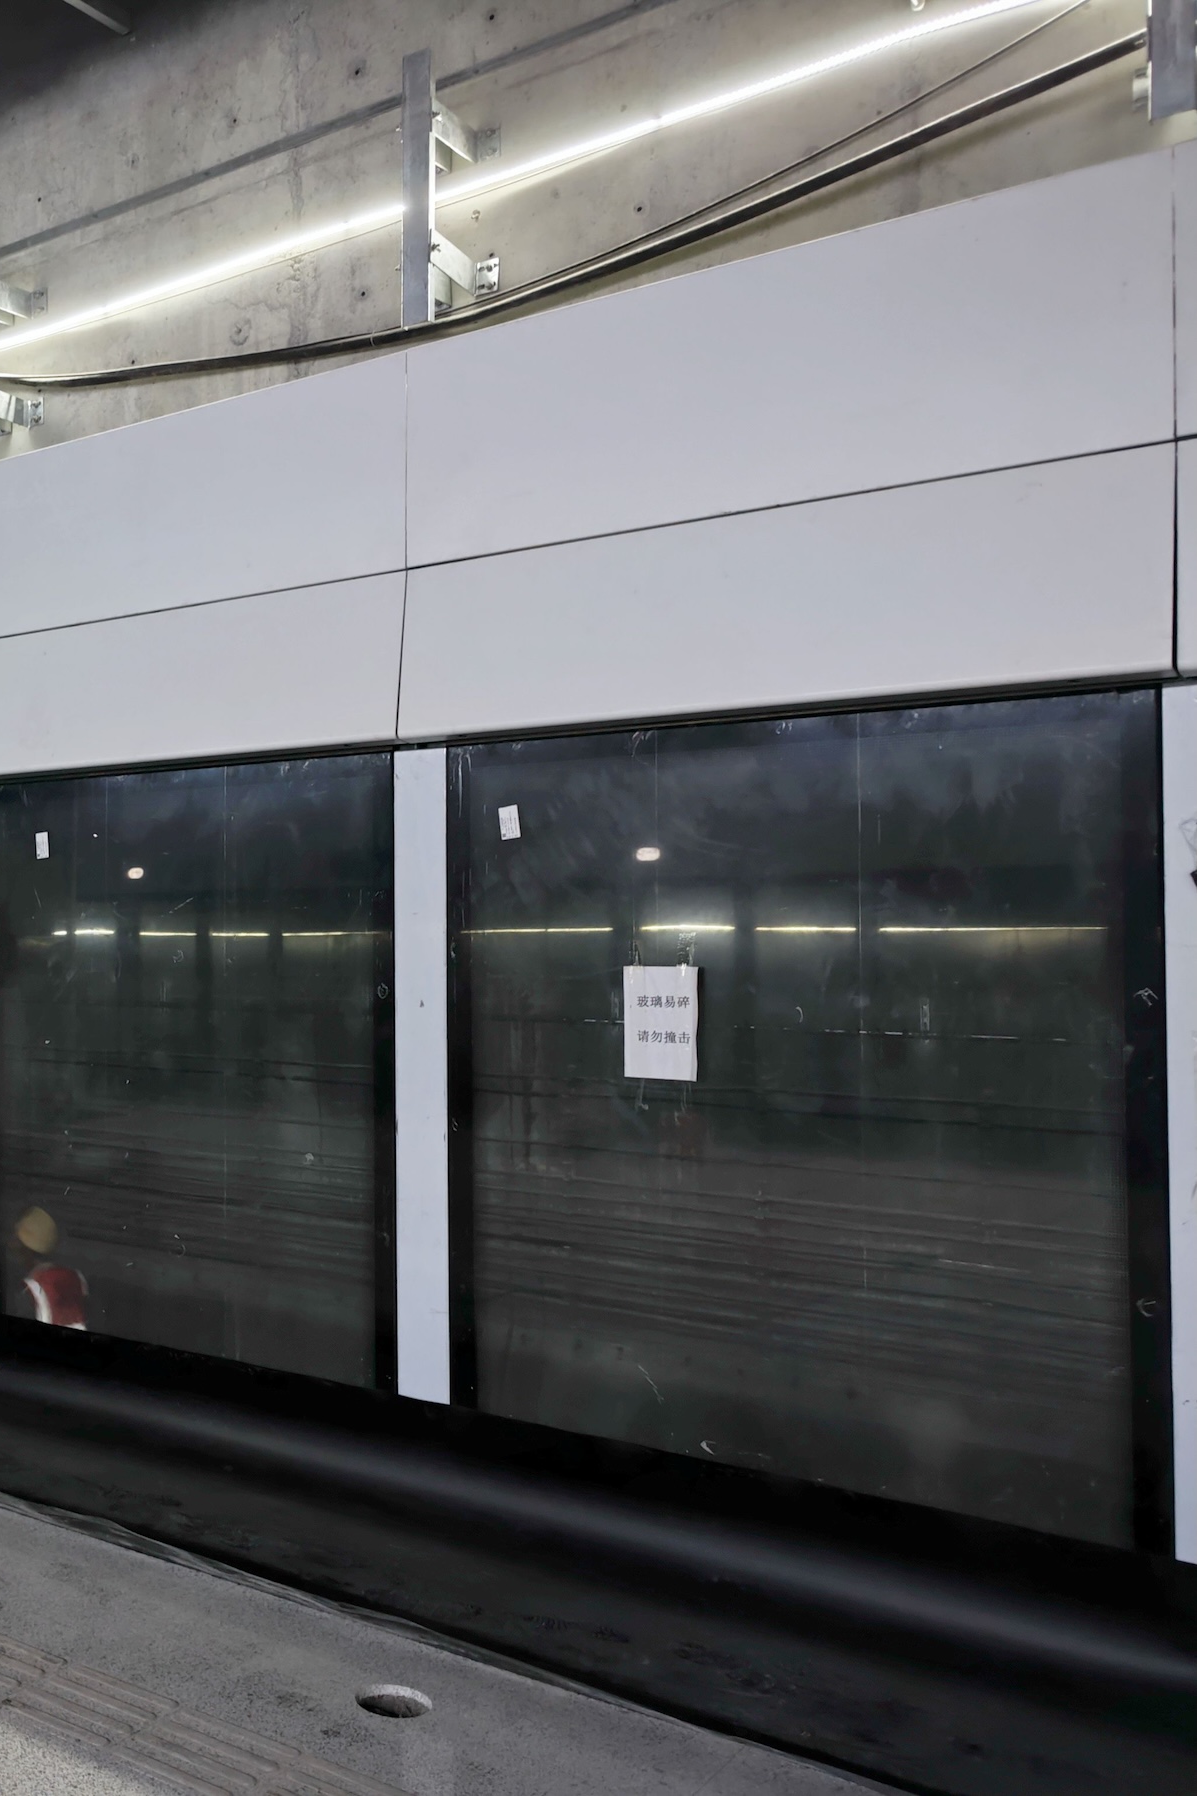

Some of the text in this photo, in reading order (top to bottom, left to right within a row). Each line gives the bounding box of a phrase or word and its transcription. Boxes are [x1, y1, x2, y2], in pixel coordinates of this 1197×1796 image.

[636, 995, 690, 1009] 玻璃易碎
[637, 1030, 691, 1044] 请勿撞击
